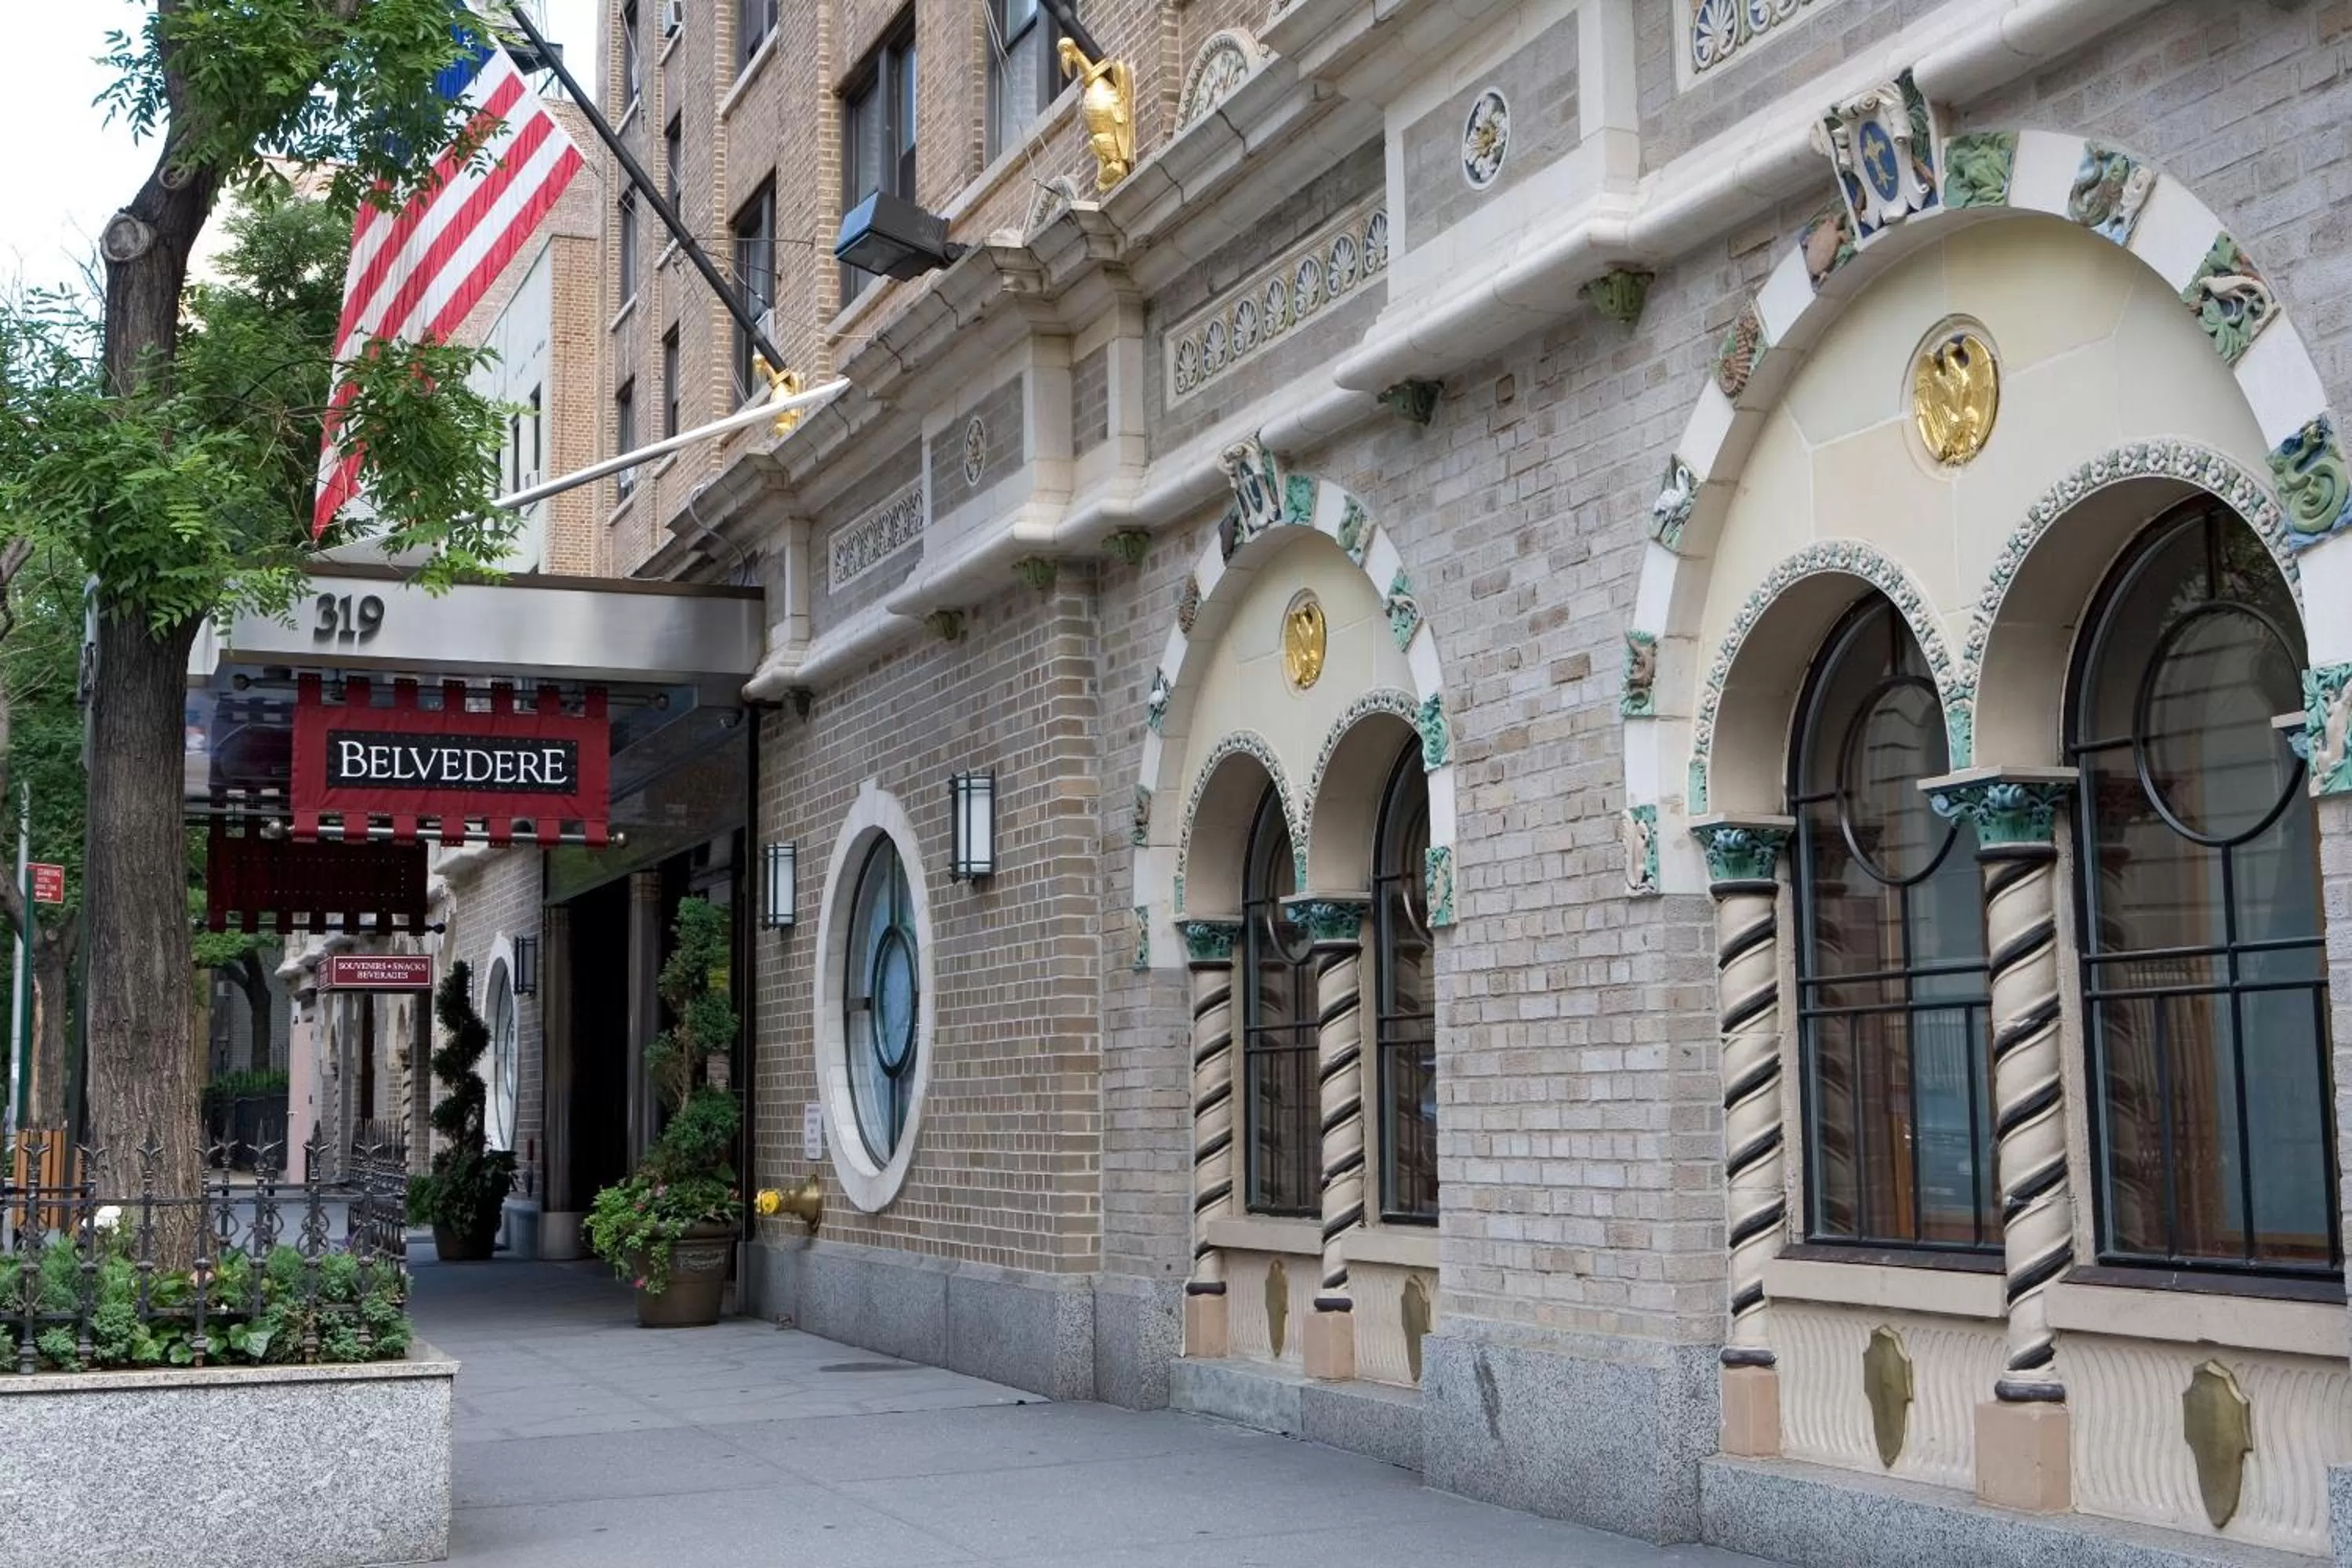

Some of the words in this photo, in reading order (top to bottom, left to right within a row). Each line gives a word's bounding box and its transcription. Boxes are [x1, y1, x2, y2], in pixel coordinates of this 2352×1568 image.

[314, 593, 384, 644] 319
[338, 740, 568, 784] BELVEDERE
[357, 971, 408, 979] BEVERAGES
[393, 962, 427, 971] SNACKS
